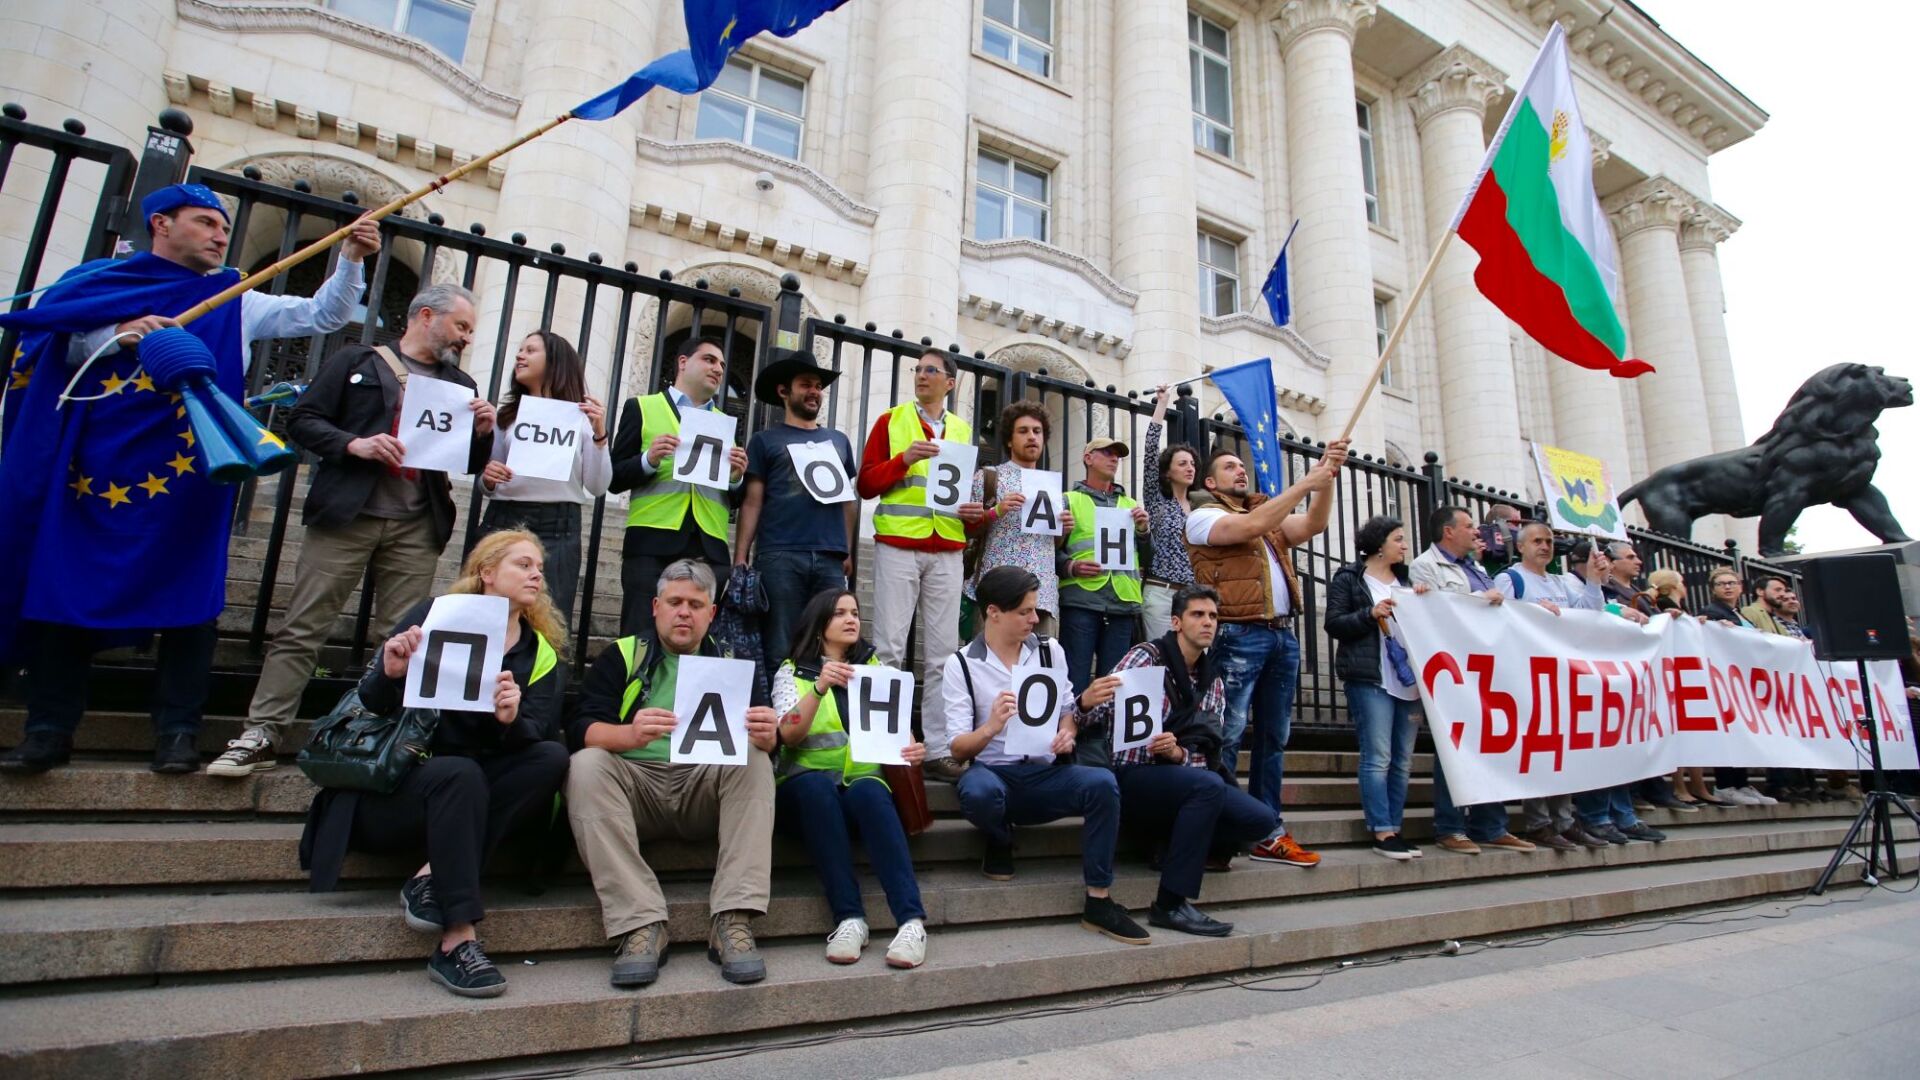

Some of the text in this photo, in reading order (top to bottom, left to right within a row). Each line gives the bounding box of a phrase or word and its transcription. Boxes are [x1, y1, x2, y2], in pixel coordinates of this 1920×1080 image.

[415, 409, 453, 433] АЗ
[514, 422, 575, 447] СЪМ
[677, 434, 724, 482] Л
[803, 460, 844, 499] О
[933, 463, 961, 507] З
[1025, 490, 1057, 531] А
[1100, 527, 1127, 566] Н
[418, 629, 489, 702] П
[678, 692, 737, 756] А
[859, 676, 901, 734] Н
[1017, 673, 1058, 728] О
[1123, 694, 1154, 744] В
[1423, 651, 1664, 774] СЪДЕБНА
